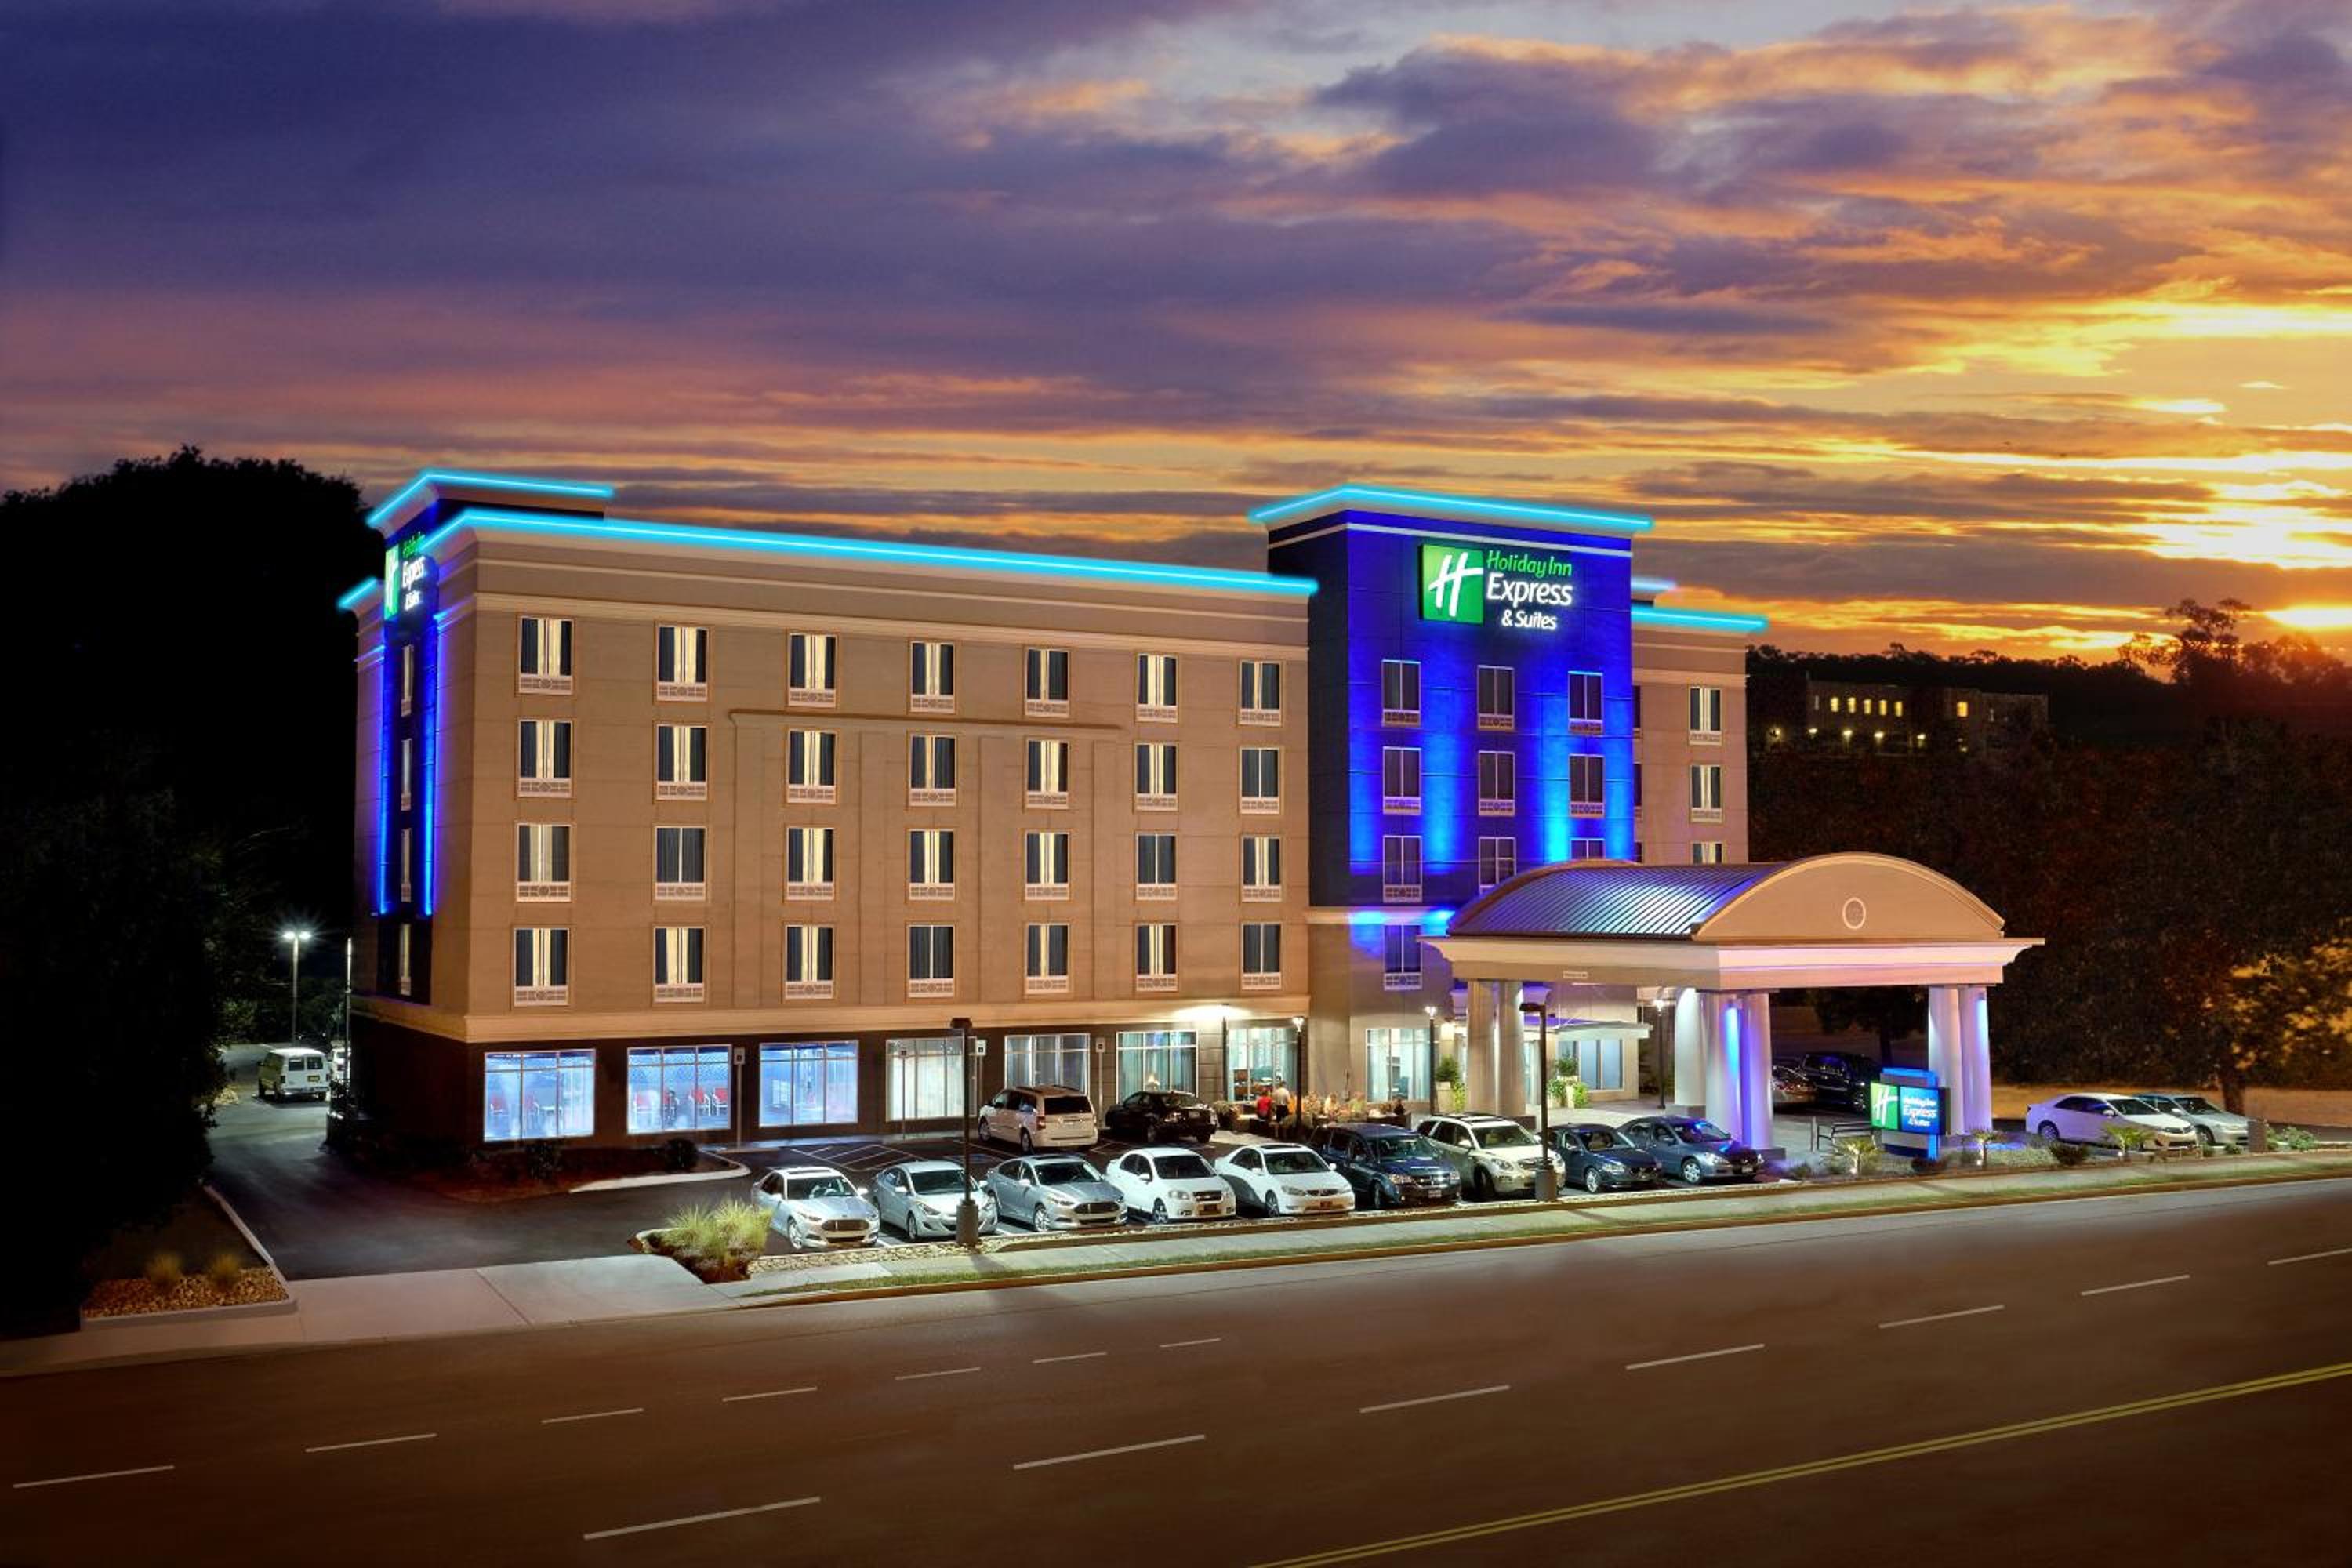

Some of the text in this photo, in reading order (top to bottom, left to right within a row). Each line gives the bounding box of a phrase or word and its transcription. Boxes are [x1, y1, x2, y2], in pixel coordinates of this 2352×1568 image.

[1486, 550, 1572, 578] Holiday Inn
[1487, 572, 1573, 608] Express
[1501, 609, 1558, 630] & Suites
